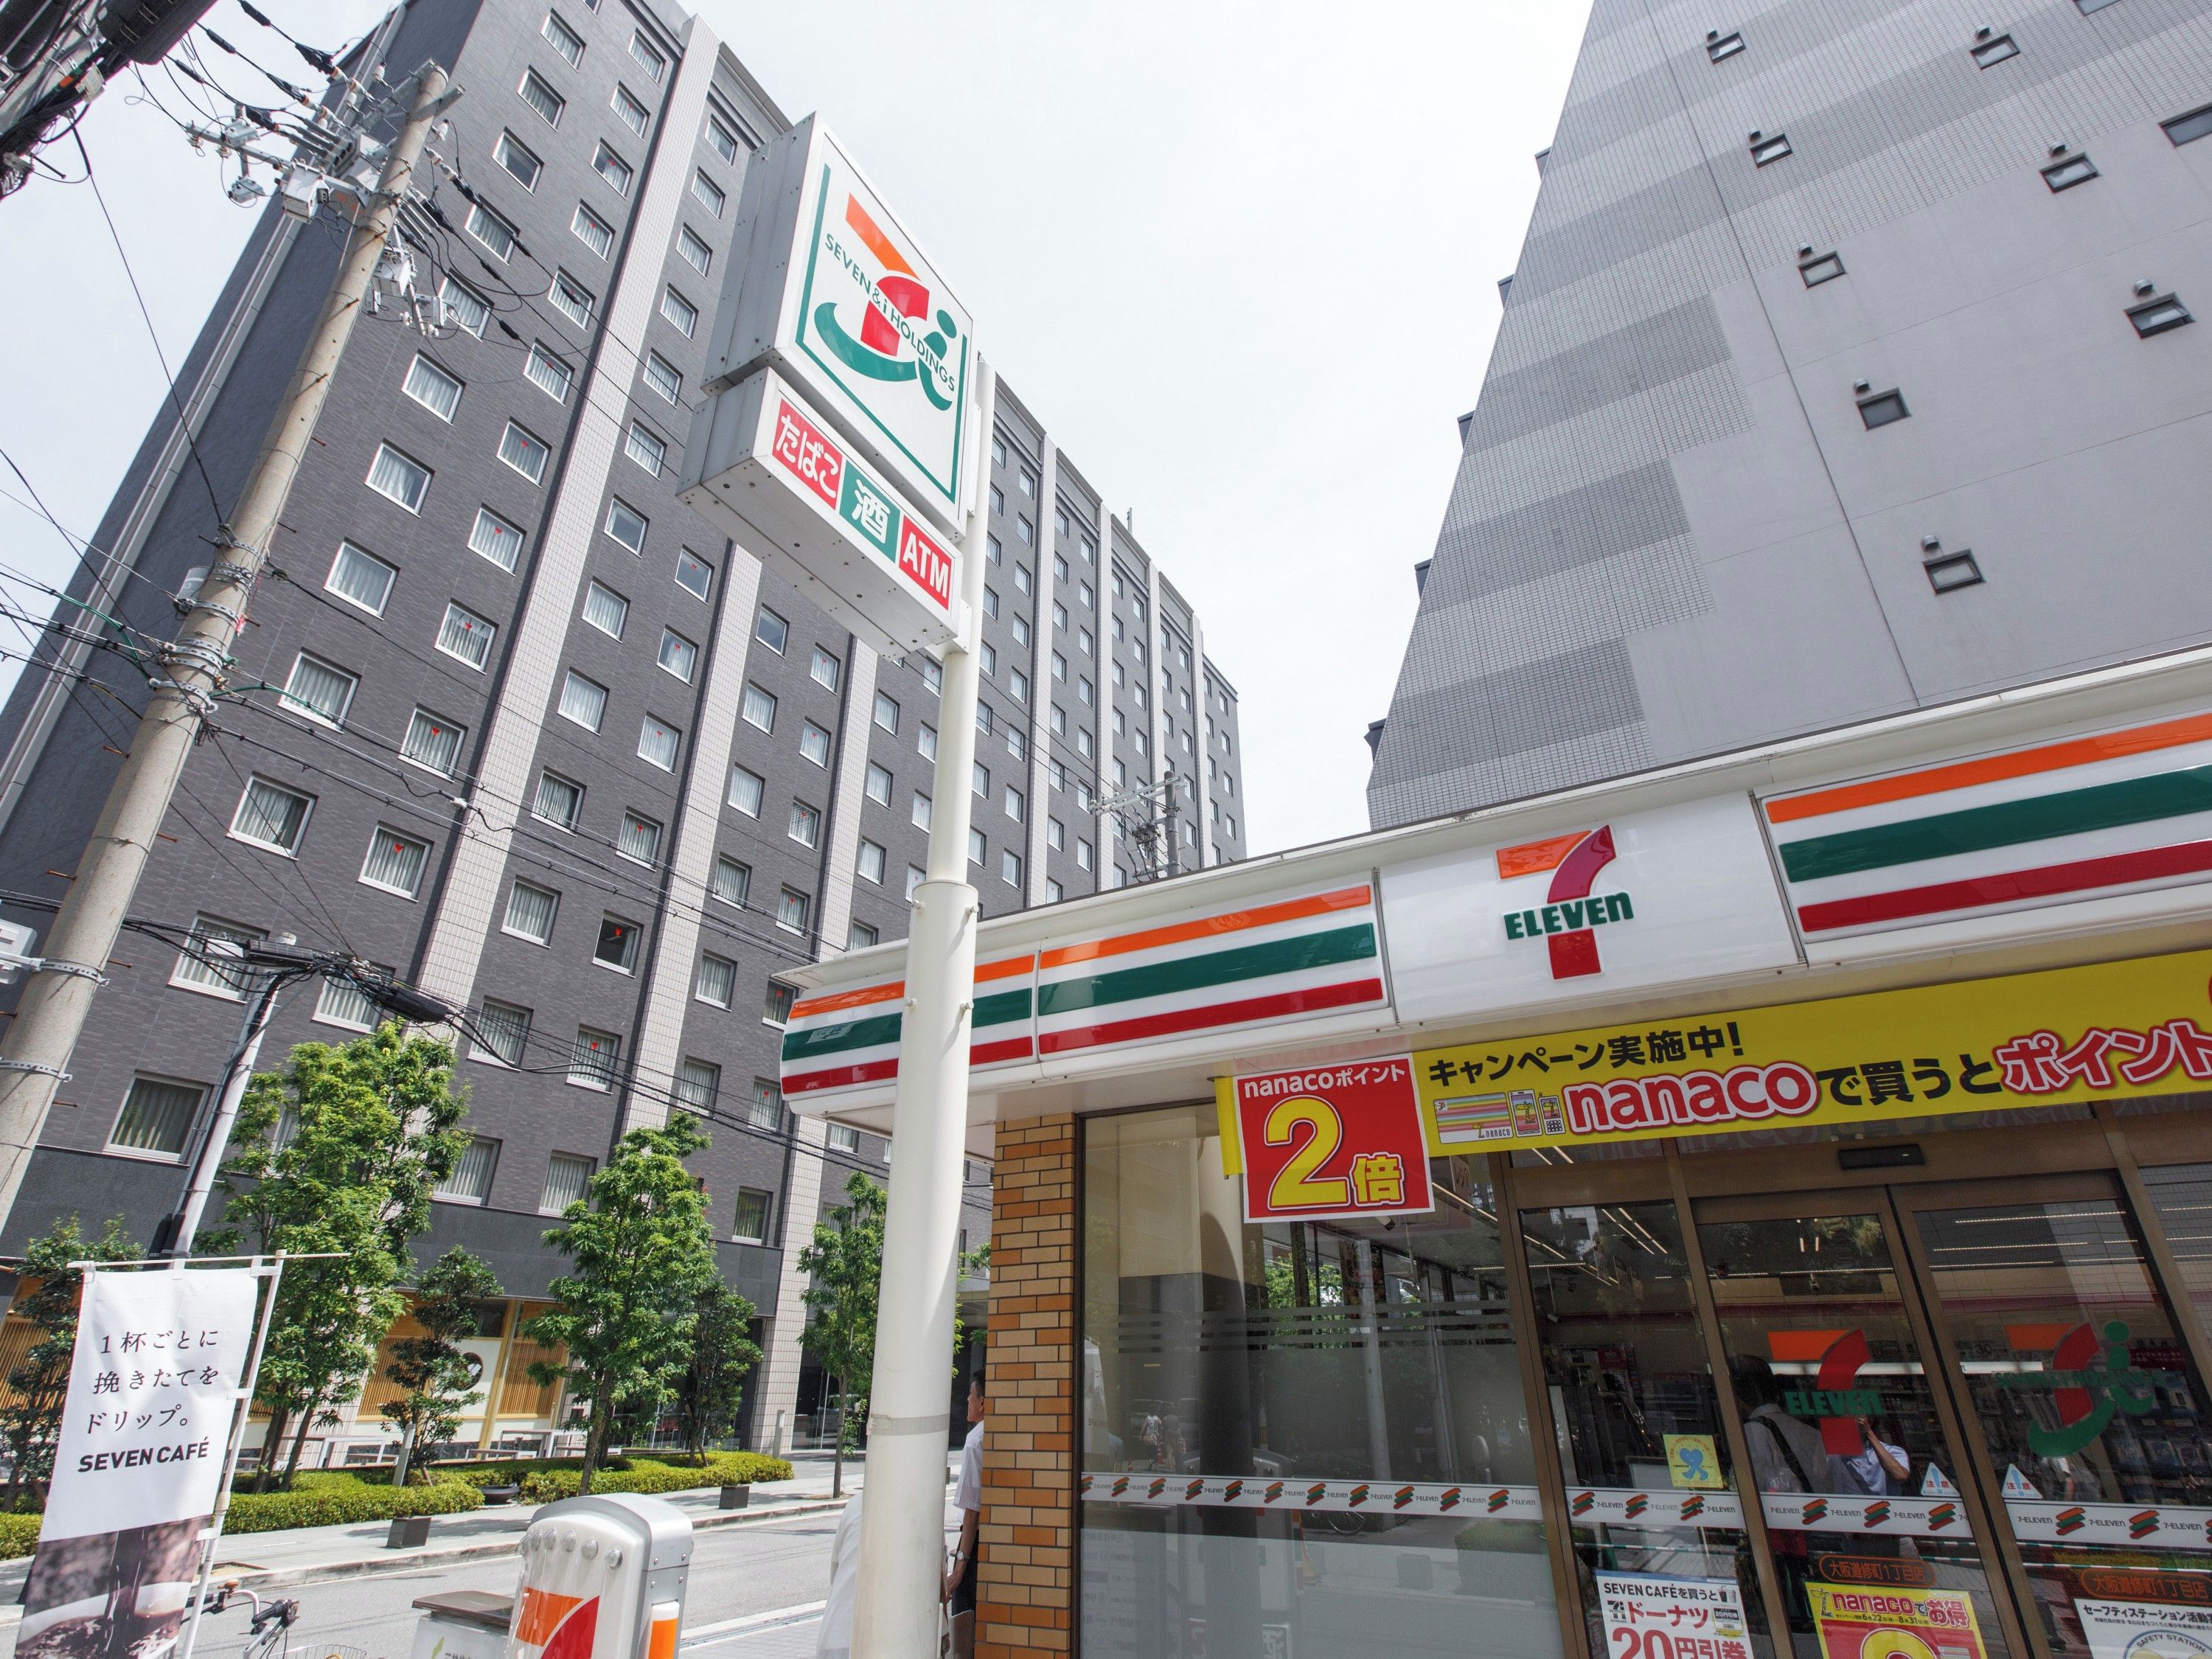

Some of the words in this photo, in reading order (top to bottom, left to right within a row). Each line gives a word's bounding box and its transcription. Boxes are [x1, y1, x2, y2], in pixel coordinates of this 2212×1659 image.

[824, 233, 872, 296] SEVEN
[889, 314, 956, 392] HOLDINGS
[776, 414, 840, 501] たばこ
[852, 478, 890, 545] 酒
[902, 532, 950, 600] ATM
[1486, 1128, 1510, 1138] nanaco
[101, 1330, 218, 1354] 1杯ごとに
[93, 1366, 219, 1394] 挽きたてを
[87, 1404, 188, 1434] ドリップ。
[77, 1448, 153, 1472] SEVEN
[156, 1436, 210, 1461] CAFÉ
[1604, 1583, 1644, 1596] SEVEN
[1627, 1601, 1708, 1629] ドーナツ
[2136, 1633, 2164, 1648] SAFETY
[2166, 1634, 2206, 1653] STATION
